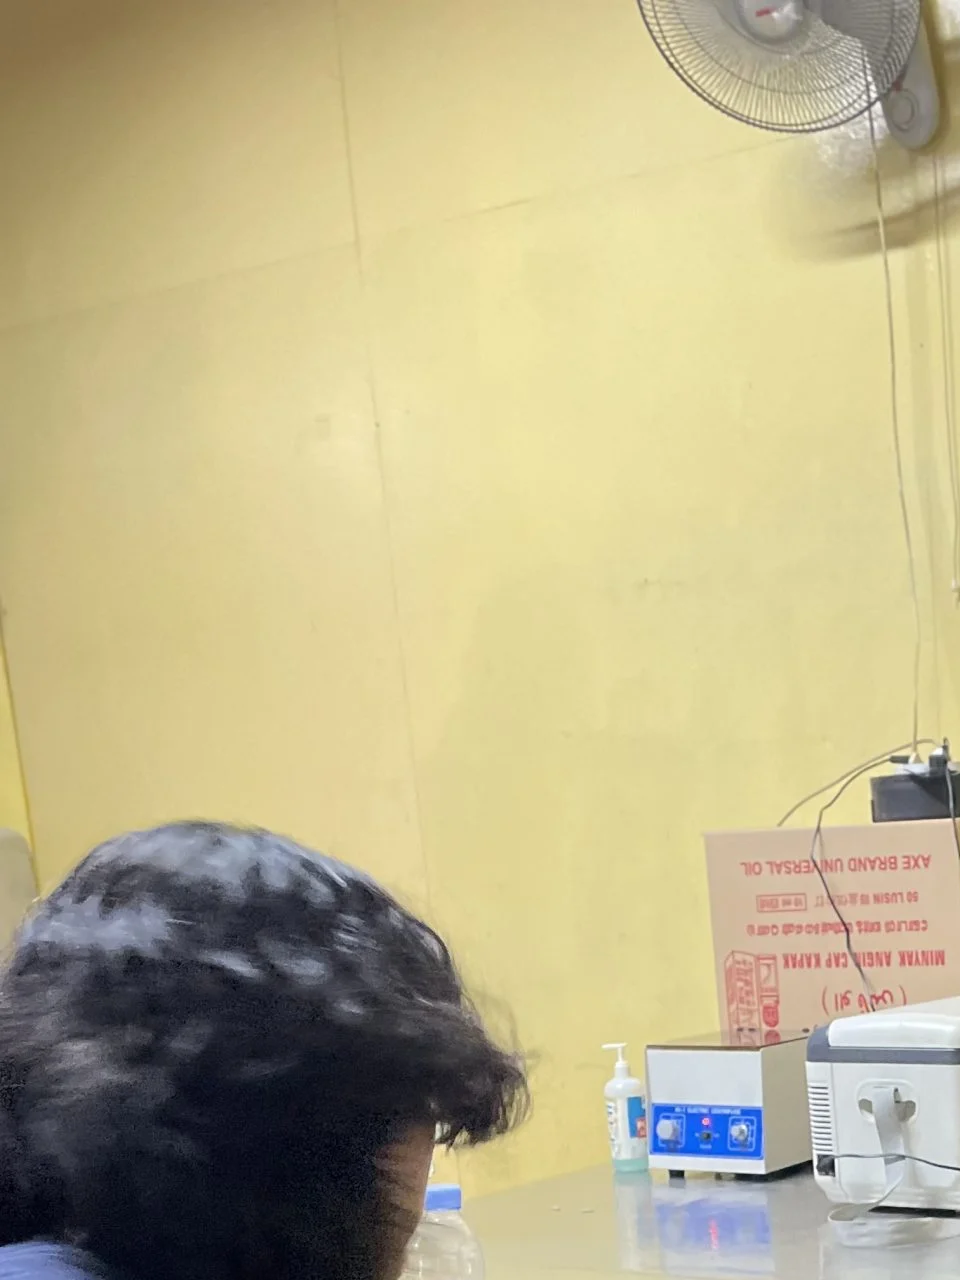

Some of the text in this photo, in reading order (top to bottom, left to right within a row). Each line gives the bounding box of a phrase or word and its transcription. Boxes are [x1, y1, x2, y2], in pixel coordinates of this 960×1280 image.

[740, 855, 932, 876] AXE BRAND UNIVERSAL OIL
[873, 891, 905, 905] LUSIN
[783, 950, 946, 970] MINYAK ANGIN CAP KAPAK
